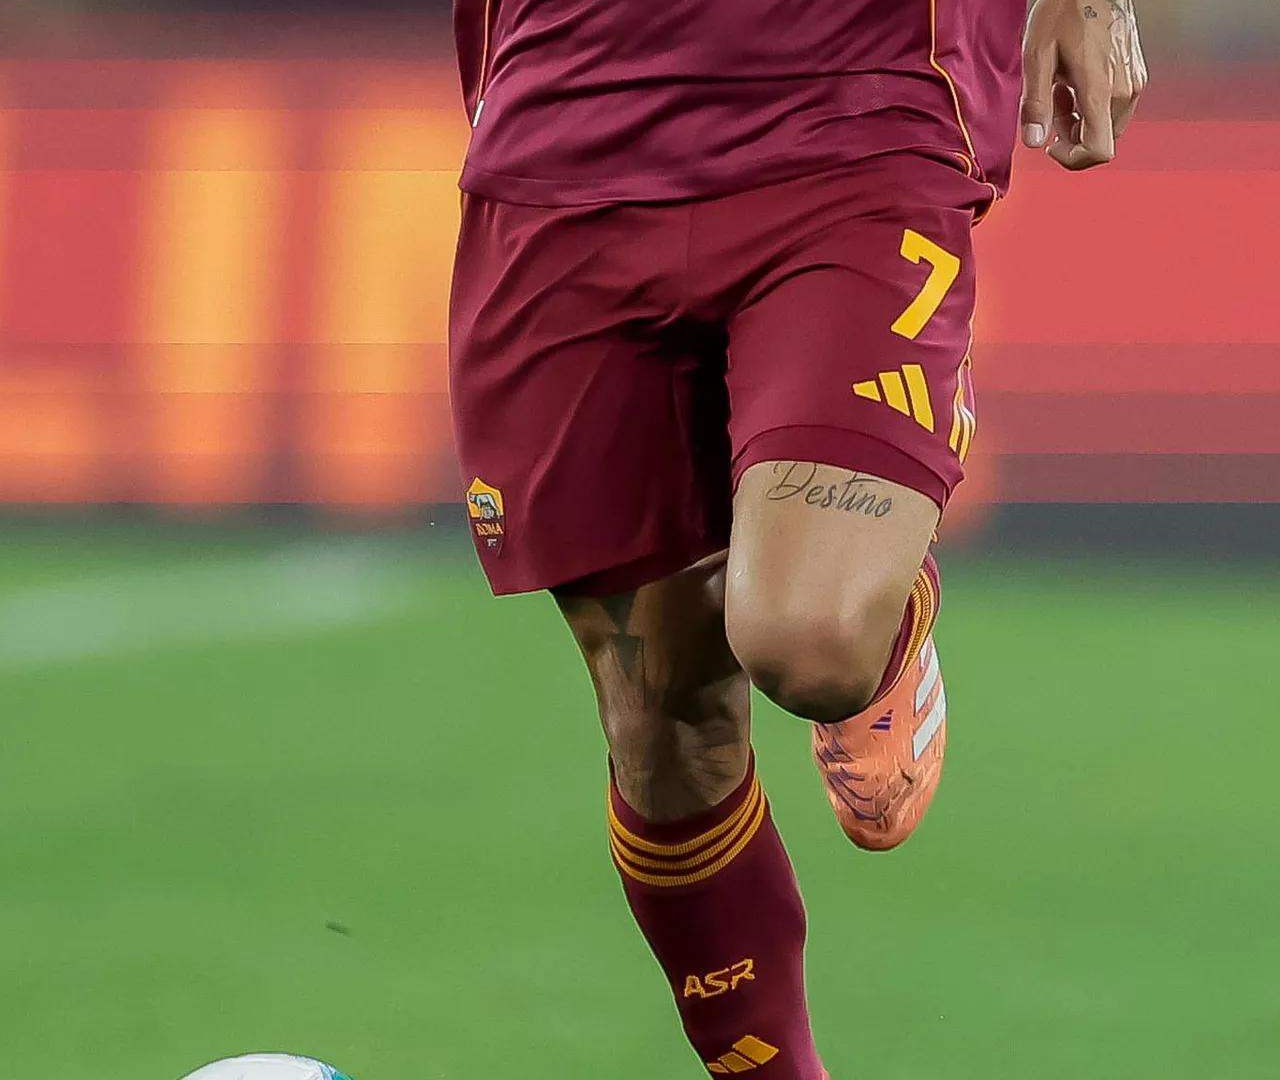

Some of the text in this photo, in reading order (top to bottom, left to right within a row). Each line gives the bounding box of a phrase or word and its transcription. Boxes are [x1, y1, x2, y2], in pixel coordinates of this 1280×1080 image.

[891, 228, 960, 340] 7
[765, 461, 893, 518] Destino
[684, 958, 756, 998] ASR
